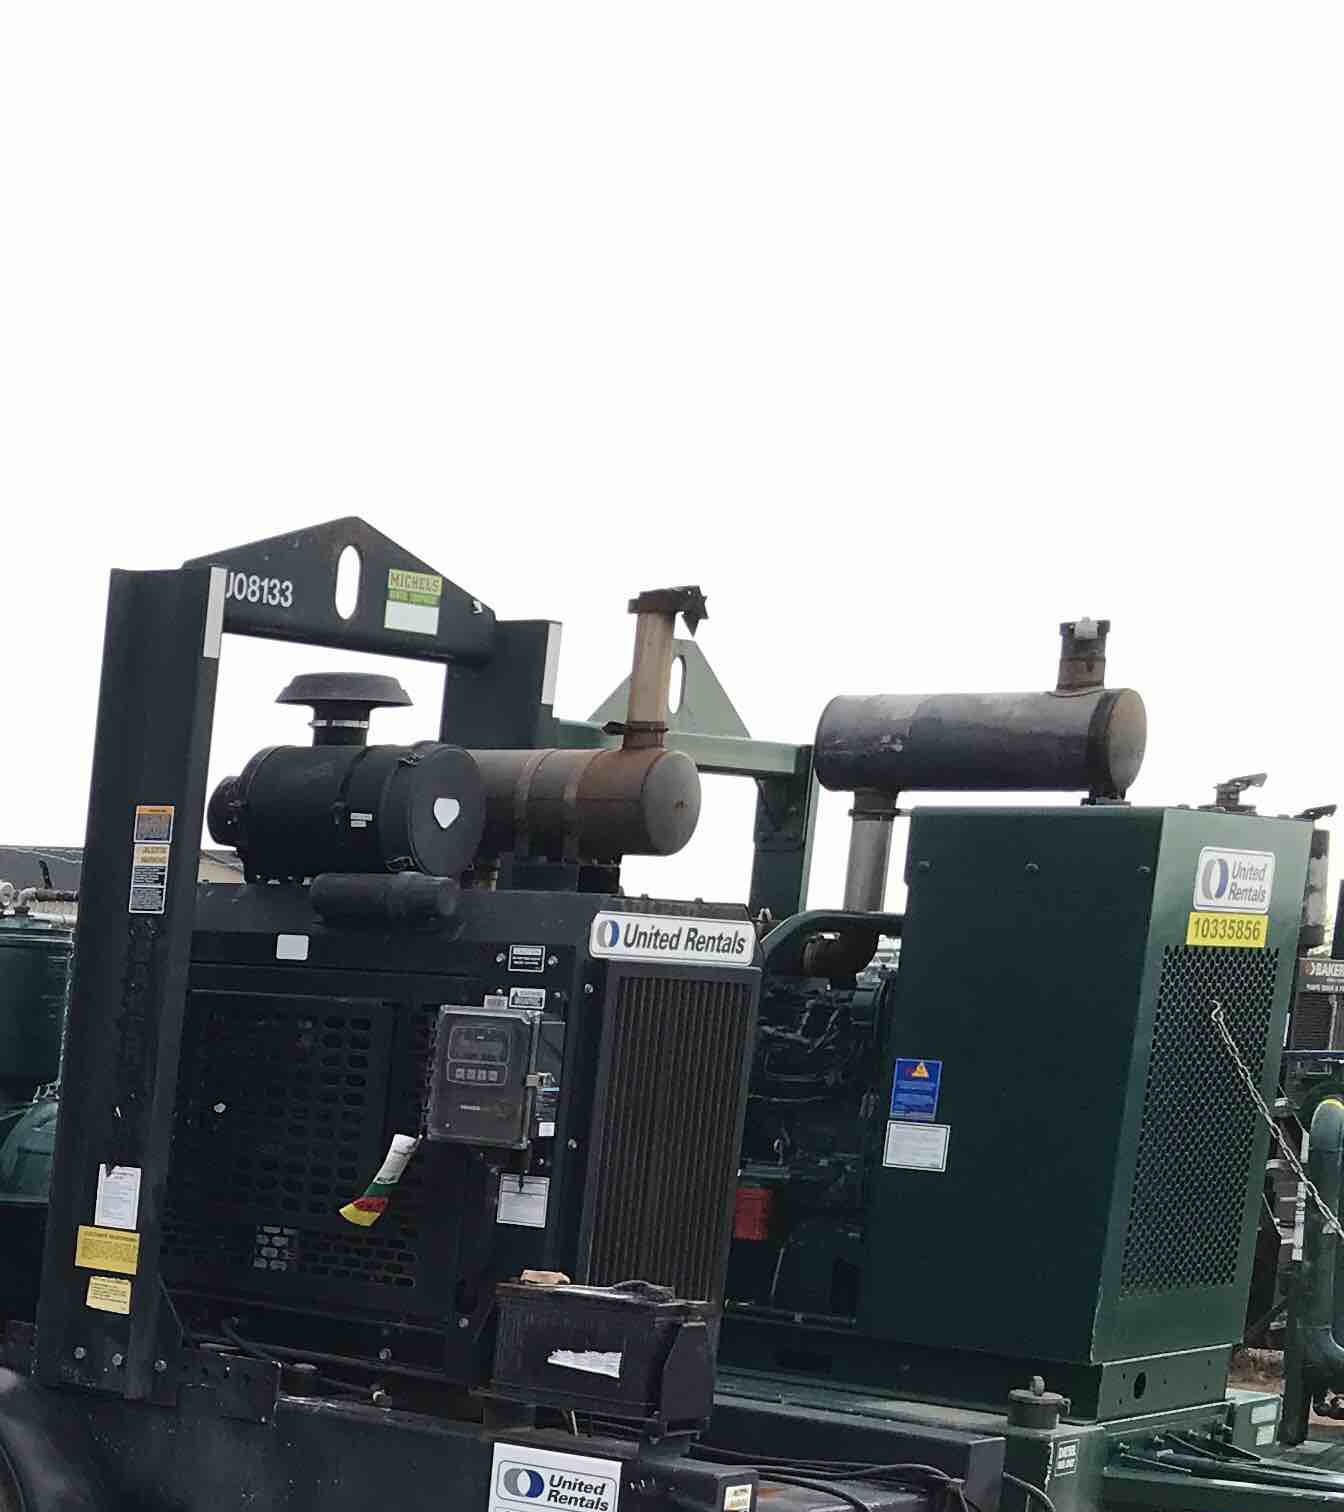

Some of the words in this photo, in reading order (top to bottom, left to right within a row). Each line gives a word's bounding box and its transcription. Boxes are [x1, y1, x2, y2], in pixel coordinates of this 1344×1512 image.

[1231, 861, 1268, 881] United
[1228, 882, 1266, 902] Rentals
[623, 922, 682, 950] United
[684, 927, 746, 954] Rentals
[1193, 917, 1261, 940] 10335856
[549, 1474, 606, 1496] United
[547, 1489, 609, 1512] Rentals
